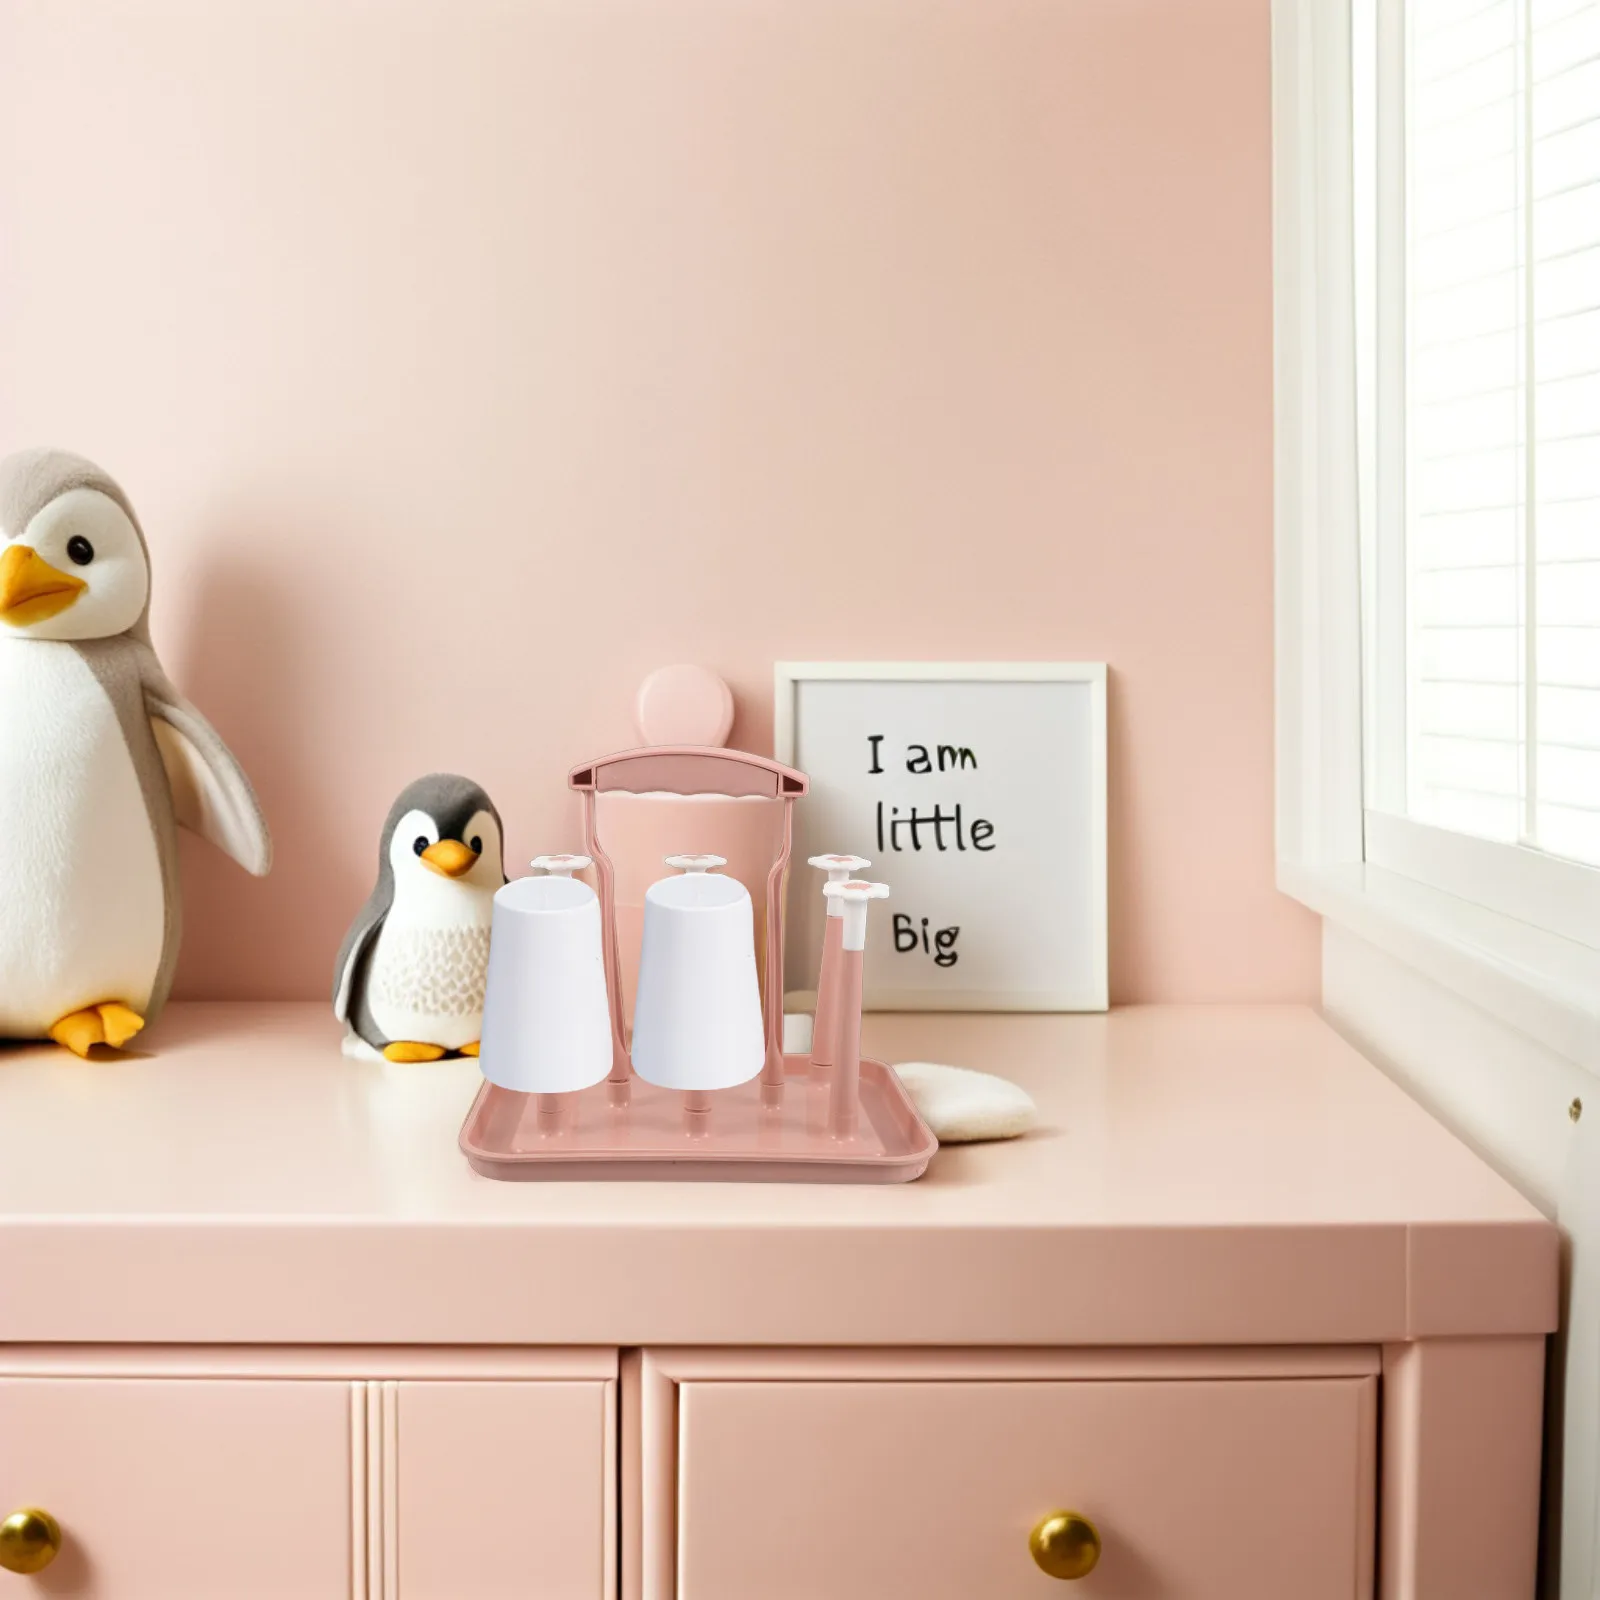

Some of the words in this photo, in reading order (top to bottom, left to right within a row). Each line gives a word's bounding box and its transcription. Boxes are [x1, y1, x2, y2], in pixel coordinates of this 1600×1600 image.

[867, 735, 884, 774] I
[906, 744, 977, 774] am
[877, 801, 996, 852] little
[892, 913, 960, 968] Big
